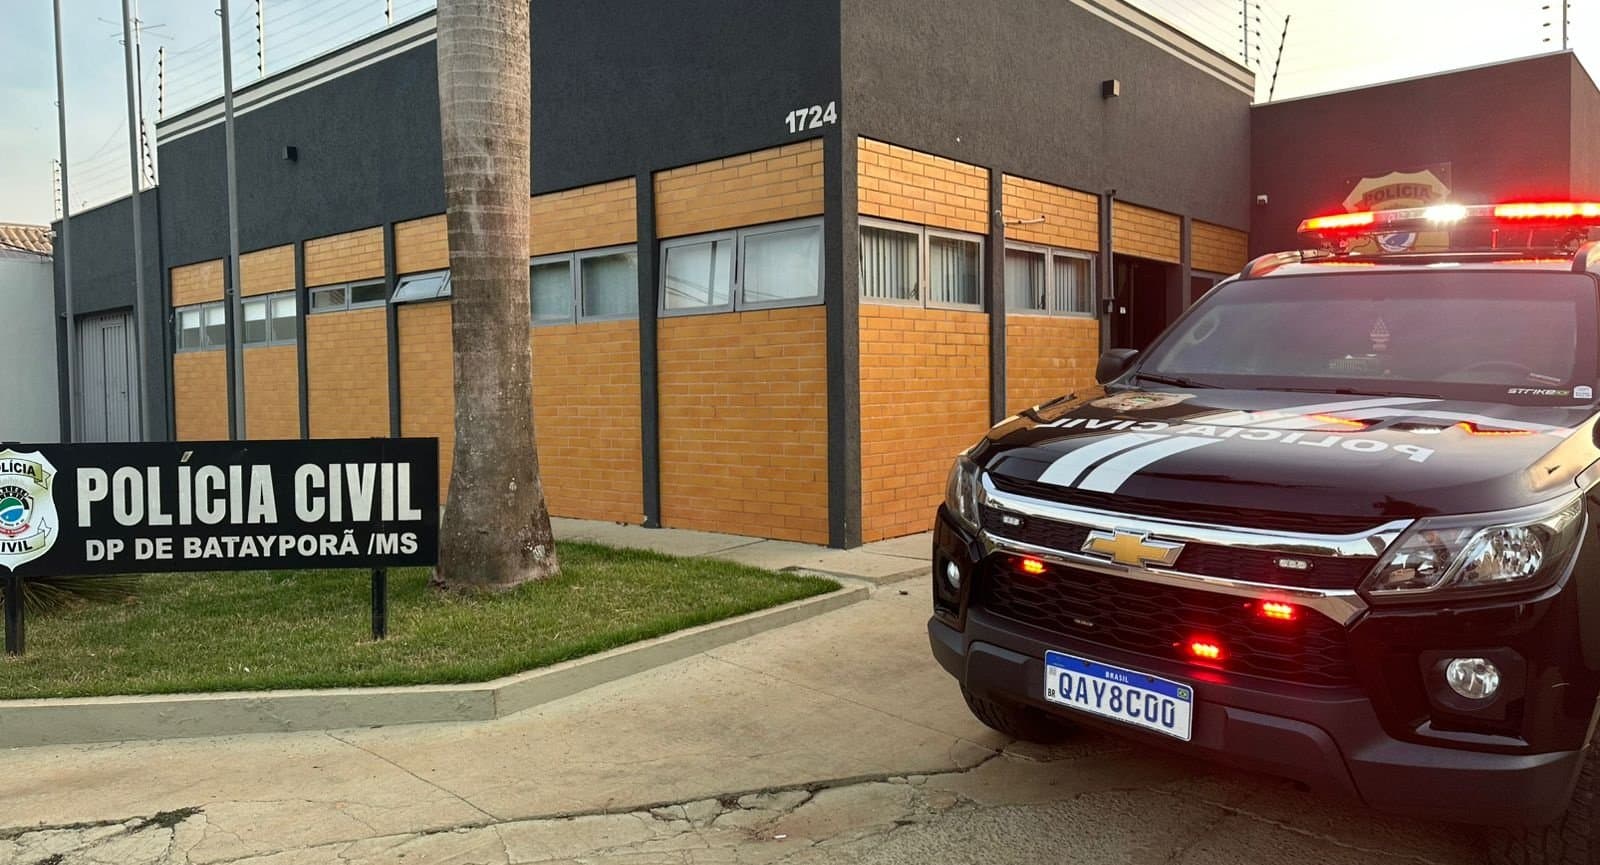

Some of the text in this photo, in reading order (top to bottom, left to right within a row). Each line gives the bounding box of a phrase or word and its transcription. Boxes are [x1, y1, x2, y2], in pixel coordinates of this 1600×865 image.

[785, 101, 837, 133] 1724
[77, 451, 422, 527] POLÍCIA CIVIL
[1, 540, 33, 552] IVIL
[86, 529, 418, 561] DP DE BATAYPORÃ /MS
[1047, 687, 1056, 698] BR
[1105, 671, 1129, 684] BRASIL
[1059, 672, 1175, 728] QAY8C00
